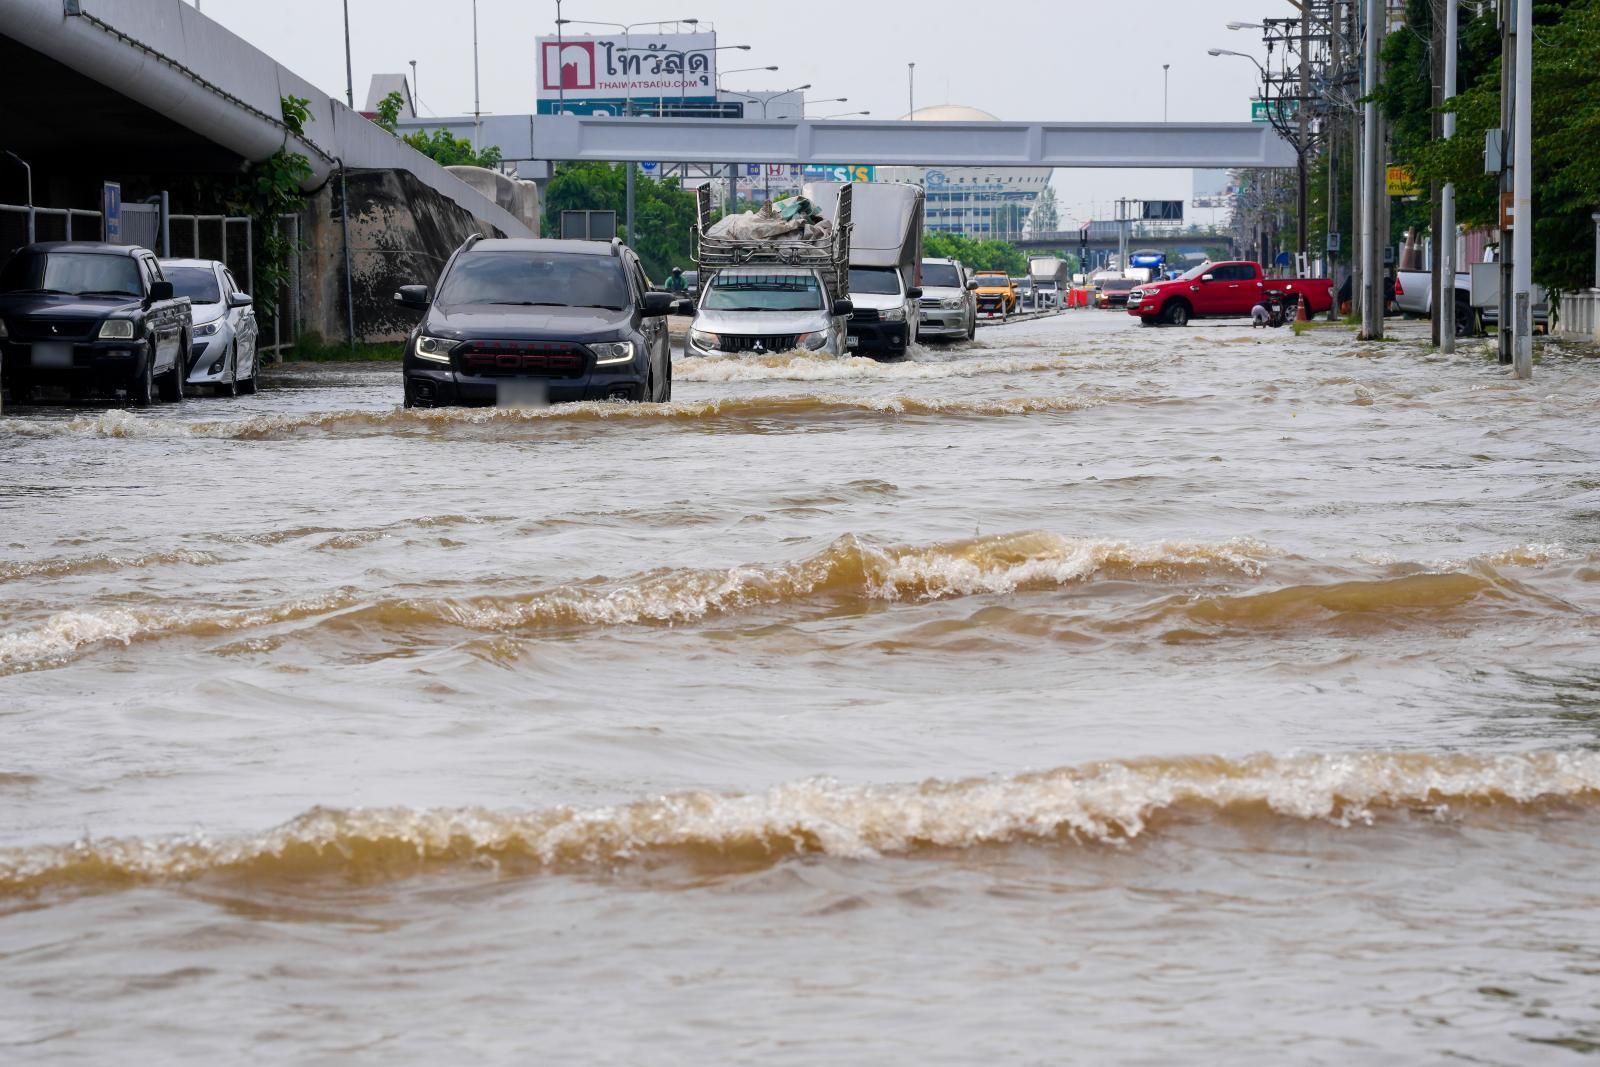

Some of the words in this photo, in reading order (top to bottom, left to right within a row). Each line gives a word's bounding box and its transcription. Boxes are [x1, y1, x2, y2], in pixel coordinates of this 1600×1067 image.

[598, 41, 709, 86] ไทวัสดุ
[599, 81, 698, 89] THAIWATSADU.COM
[463, 353, 583, 368] FORD
